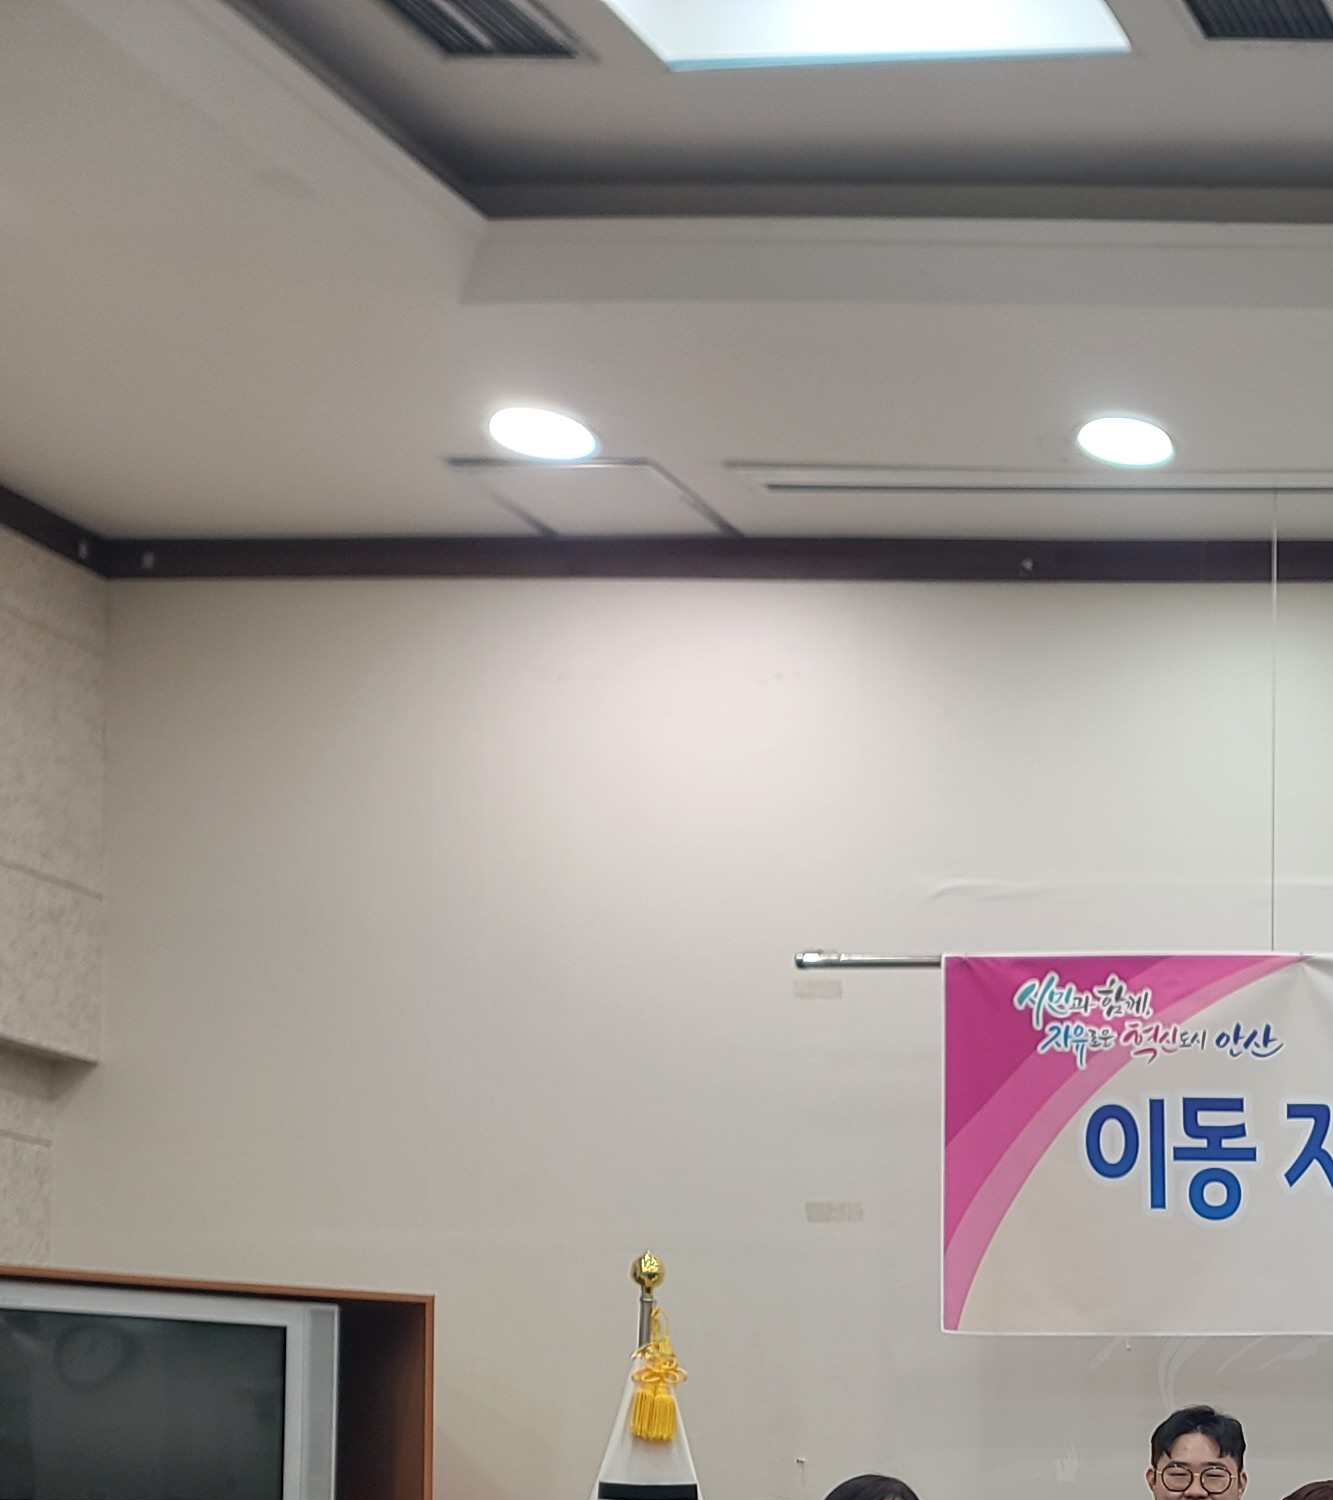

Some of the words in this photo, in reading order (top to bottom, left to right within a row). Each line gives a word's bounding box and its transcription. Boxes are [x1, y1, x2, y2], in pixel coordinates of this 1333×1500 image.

[1016, 975, 1095, 1028] 시민과
[1039, 1023, 1115, 1068] 자유로운
[1121, 1023, 1207, 1064] 혁신도시
[1214, 1022, 1284, 1058] 안산
[1085, 1097, 1258, 1222] 이동
